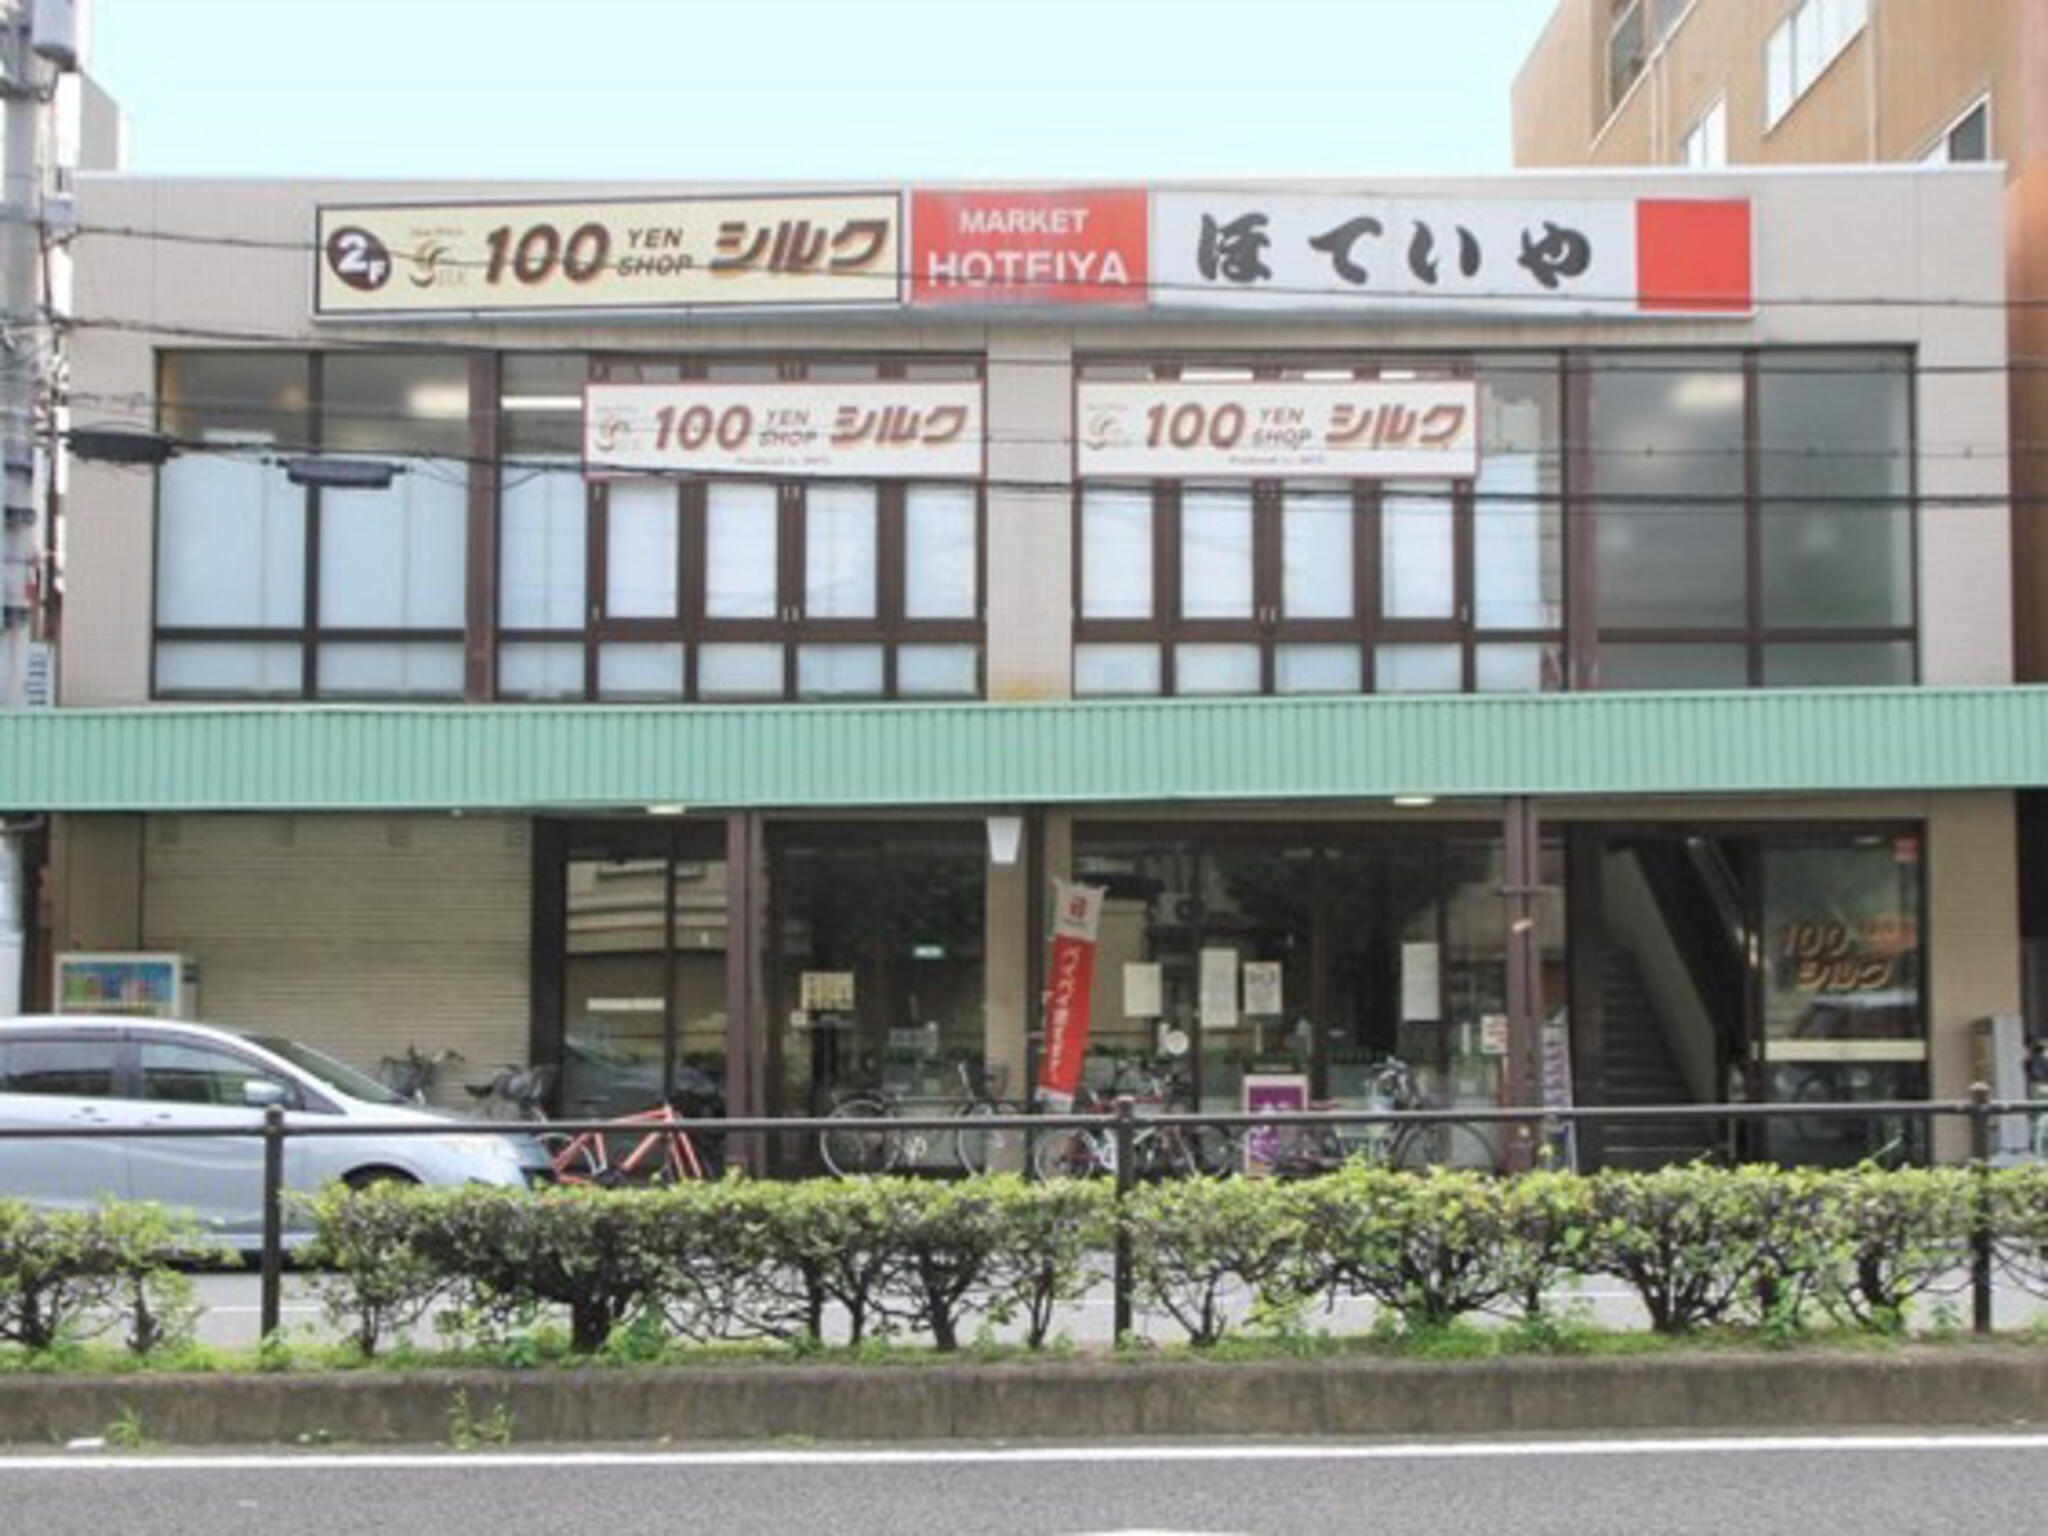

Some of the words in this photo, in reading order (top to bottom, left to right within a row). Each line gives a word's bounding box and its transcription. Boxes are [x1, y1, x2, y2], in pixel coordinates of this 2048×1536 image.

[627, 227, 684, 248] YEN
[958, 208, 1090, 234] MARKET
[486, 223, 611, 285] 100
[617, 253, 695, 277] SHOP
[709, 219, 889, 276] シルク
[1197, 212, 1593, 290] ほていや
[928, 249, 1128, 288] HOTEIYA
[653, 405, 752, 451] 100
[766, 409, 810, 425] YEN
[830, 405, 968, 443] シルク
[1146, 403, 1246, 449] 100
[1259, 407, 1303, 424] YEN
[1325, 403, 1466, 445] シルク
[758, 430, 818, 447] SHOP
[1252, 428, 1312, 447] SHOP
